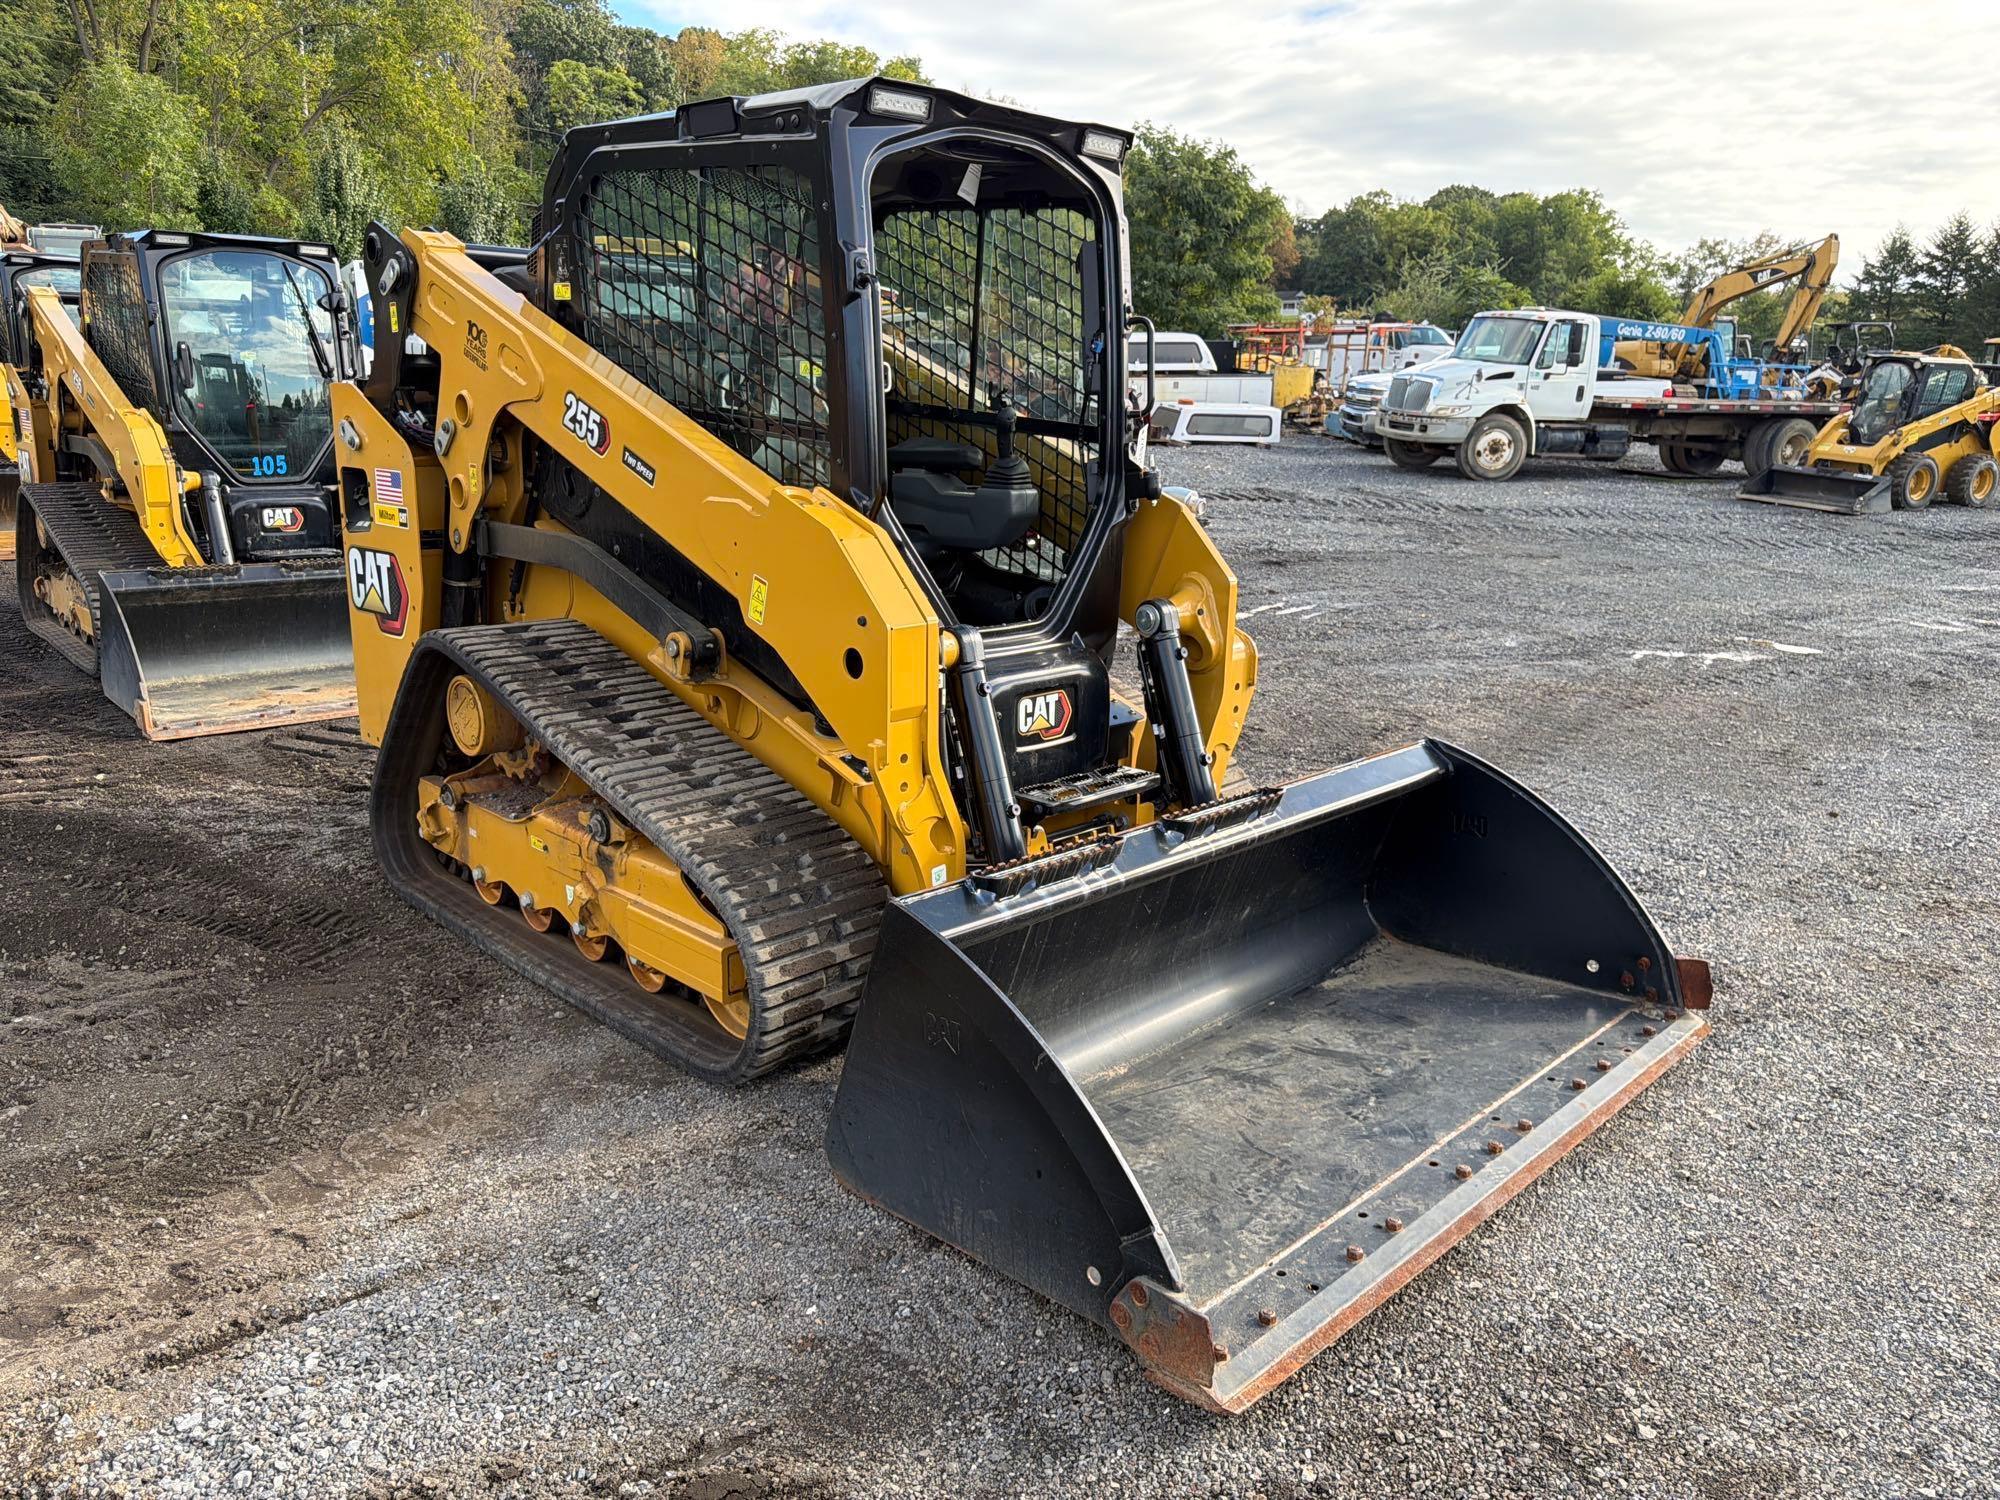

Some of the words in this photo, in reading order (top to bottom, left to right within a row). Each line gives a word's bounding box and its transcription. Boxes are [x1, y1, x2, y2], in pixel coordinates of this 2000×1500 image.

[1757, 269, 1771, 284] CAT
[1617, 323, 1643, 337] Genie
[1645, 325, 1686, 341] Z-80/60
[466, 336, 487, 359] YEARS
[563, 392, 601, 448] 255
[252, 455, 287, 476] 105
[262, 507, 293, 528] CAT
[378, 508, 396, 522] Milton
[348, 547, 392, 615] CAT
[1019, 693, 1059, 733] CAT
